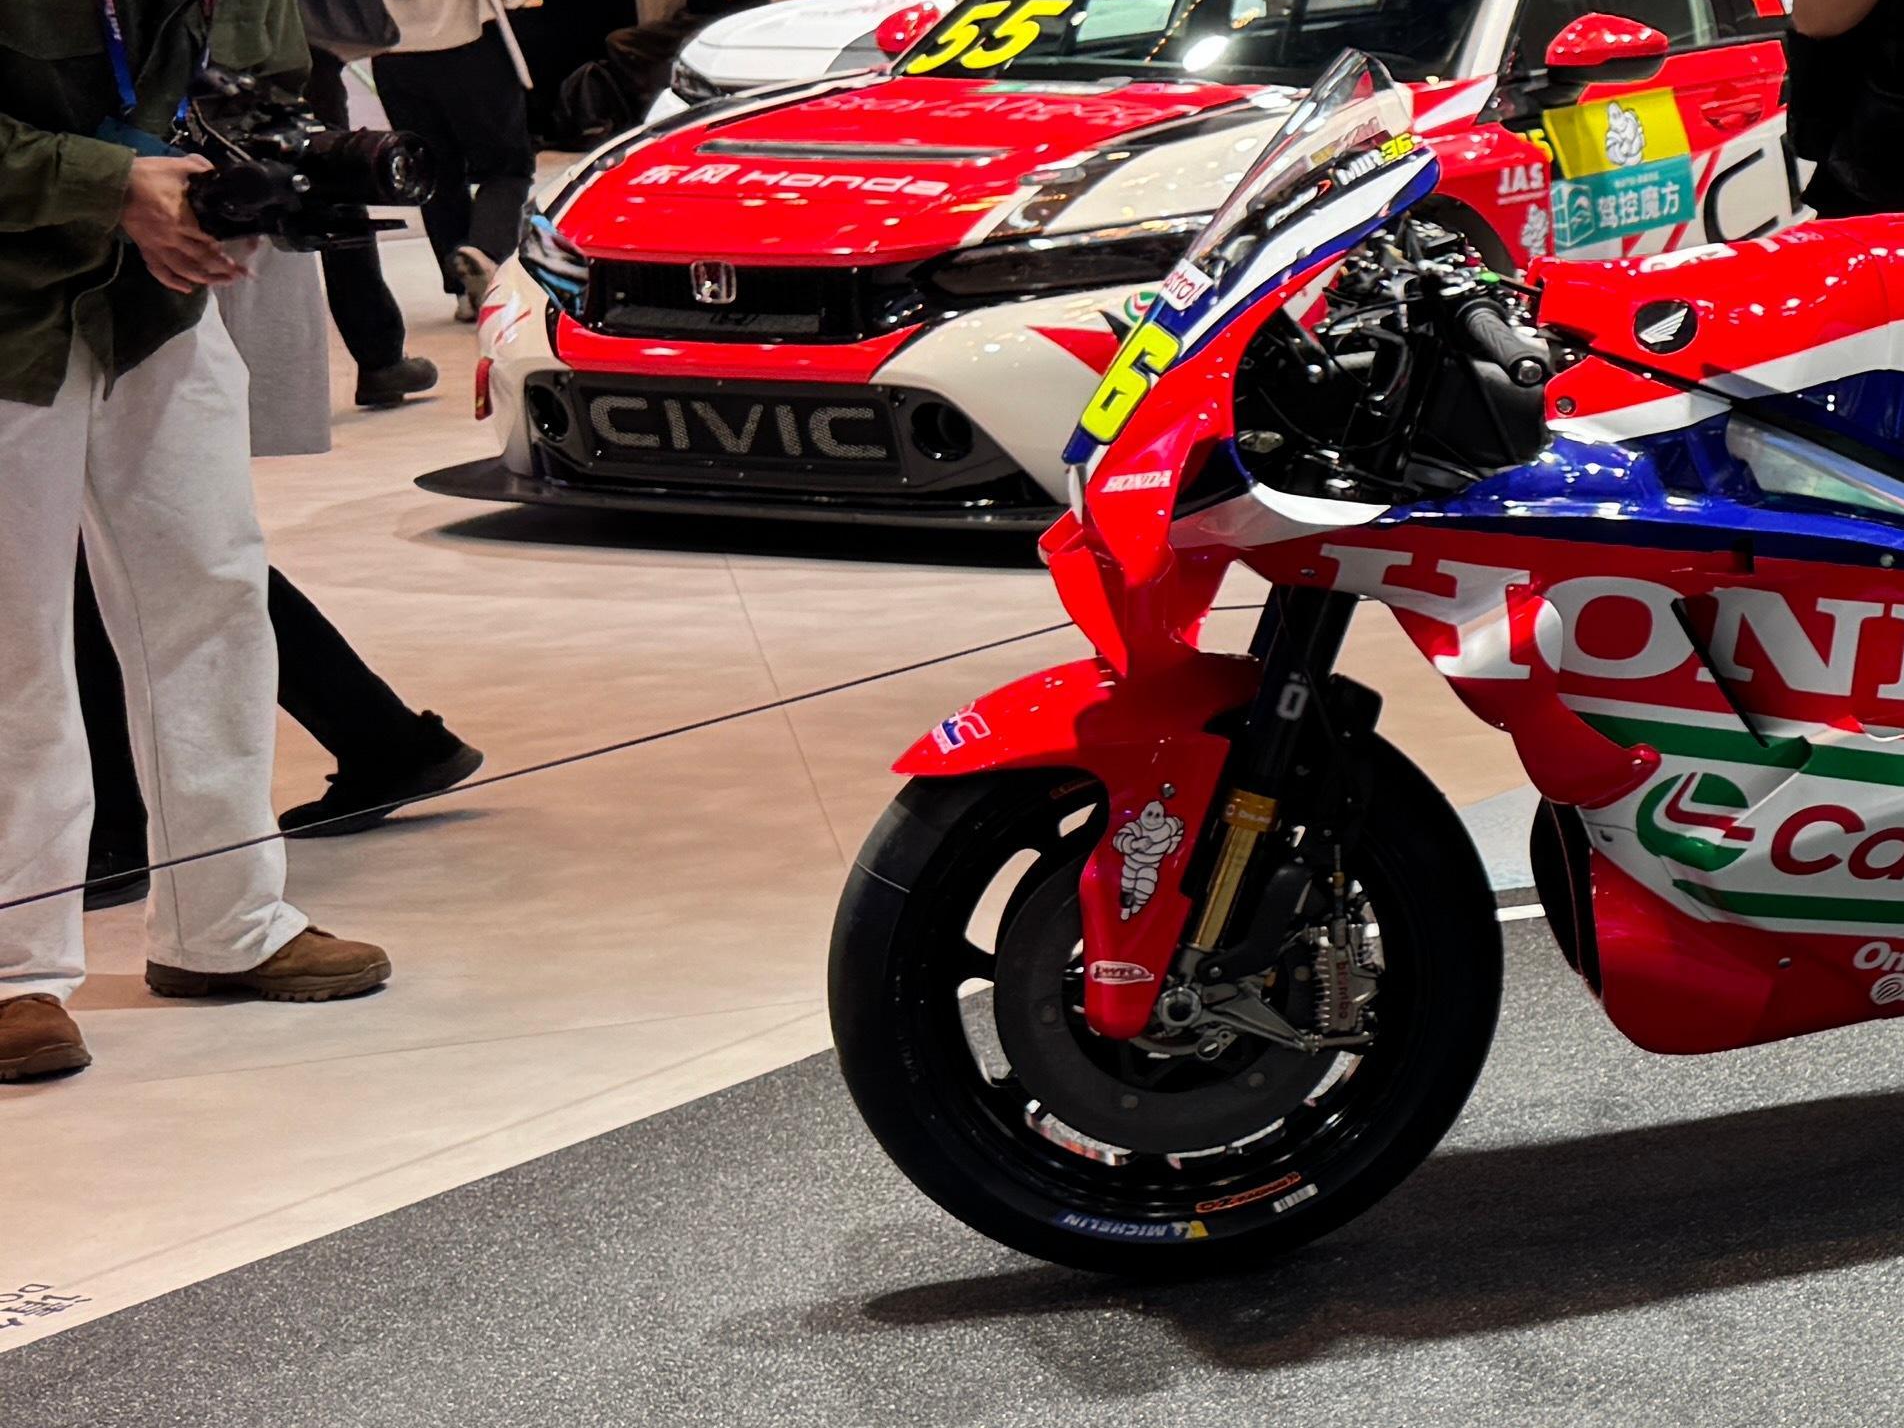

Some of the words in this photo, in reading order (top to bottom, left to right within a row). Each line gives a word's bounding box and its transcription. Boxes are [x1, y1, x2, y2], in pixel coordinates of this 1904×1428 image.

[629, 162, 742, 187] 东风
[737, 168, 954, 198] Honda
[1498, 162, 1544, 195] JAS
[1598, 180, 1682, 230] 驾控魔方
[587, 394, 889, 461] CIVIC
[1101, 470, 1173, 494] HONDA
[1062, 1212, 1168, 1238] MICHELIN
